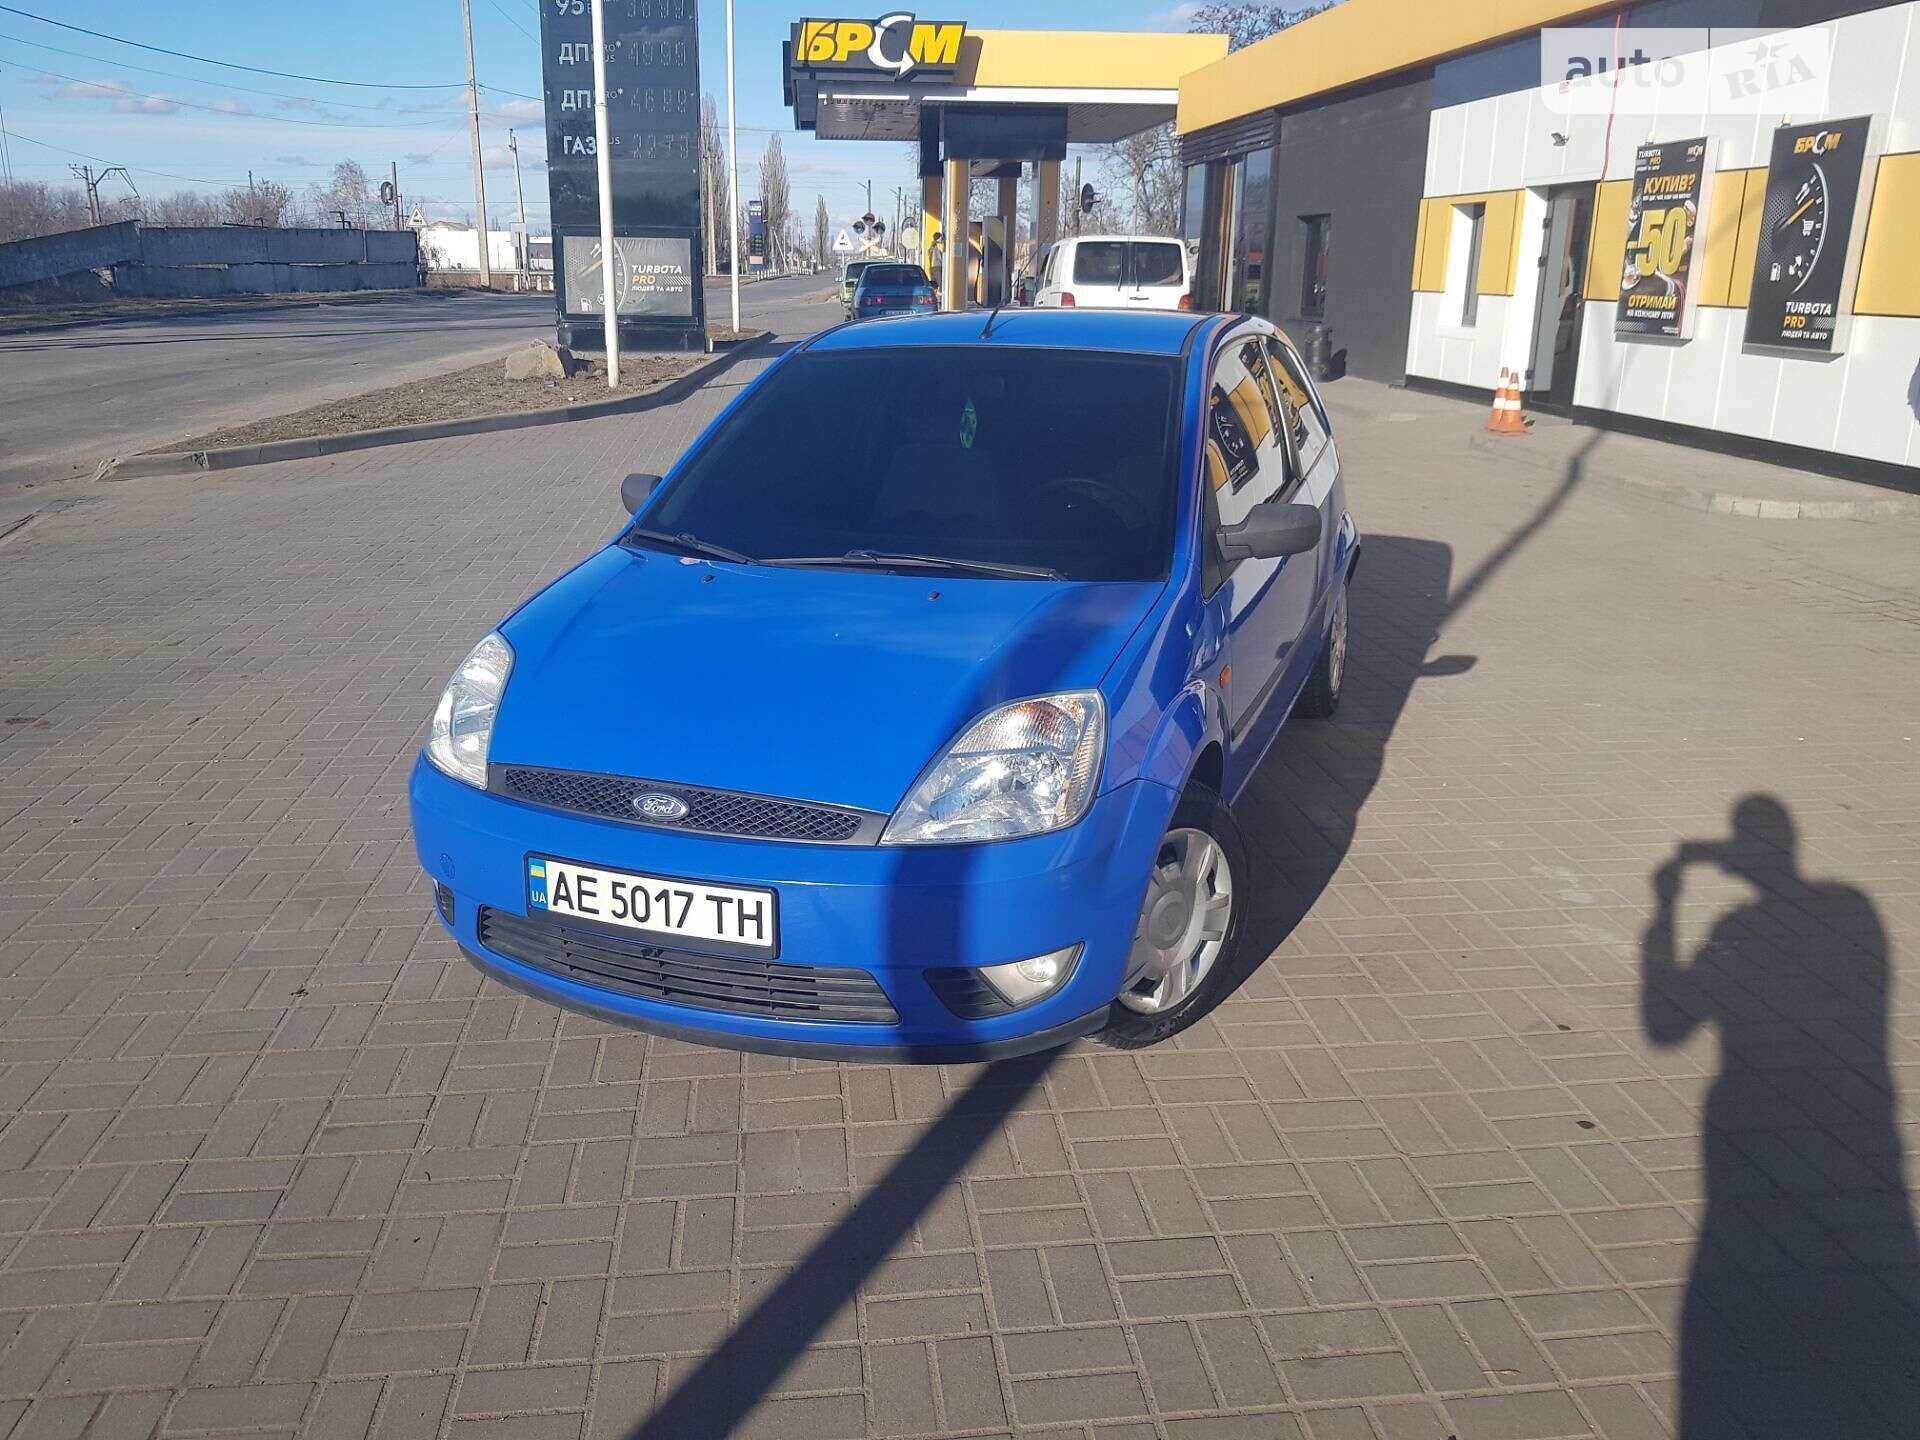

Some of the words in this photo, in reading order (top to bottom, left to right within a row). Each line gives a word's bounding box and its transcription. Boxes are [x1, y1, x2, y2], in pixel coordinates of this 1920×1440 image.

[559, 43, 589, 65] ДП
[797, 15, 964, 75] БРСМ
[561, 89, 591, 112] ДП
[563, 136, 598, 155] ГАЗ
[1793, 130, 1842, 156] БРСМ
[1643, 173, 1696, 194] КУПИВ?
[631, 264, 683, 275] TURBOTA
[632, 275, 657, 285] PRO
[1627, 293, 1677, 310] ОТРИМАЙ
[1785, 301, 1832, 316] TURBOTA
[1783, 315, 1806, 329] PRO
[531, 889, 547, 904] UA
[552, 870, 600, 916] AE
[611, 881, 694, 929] 5017
[706, 893, 764, 940] TH
